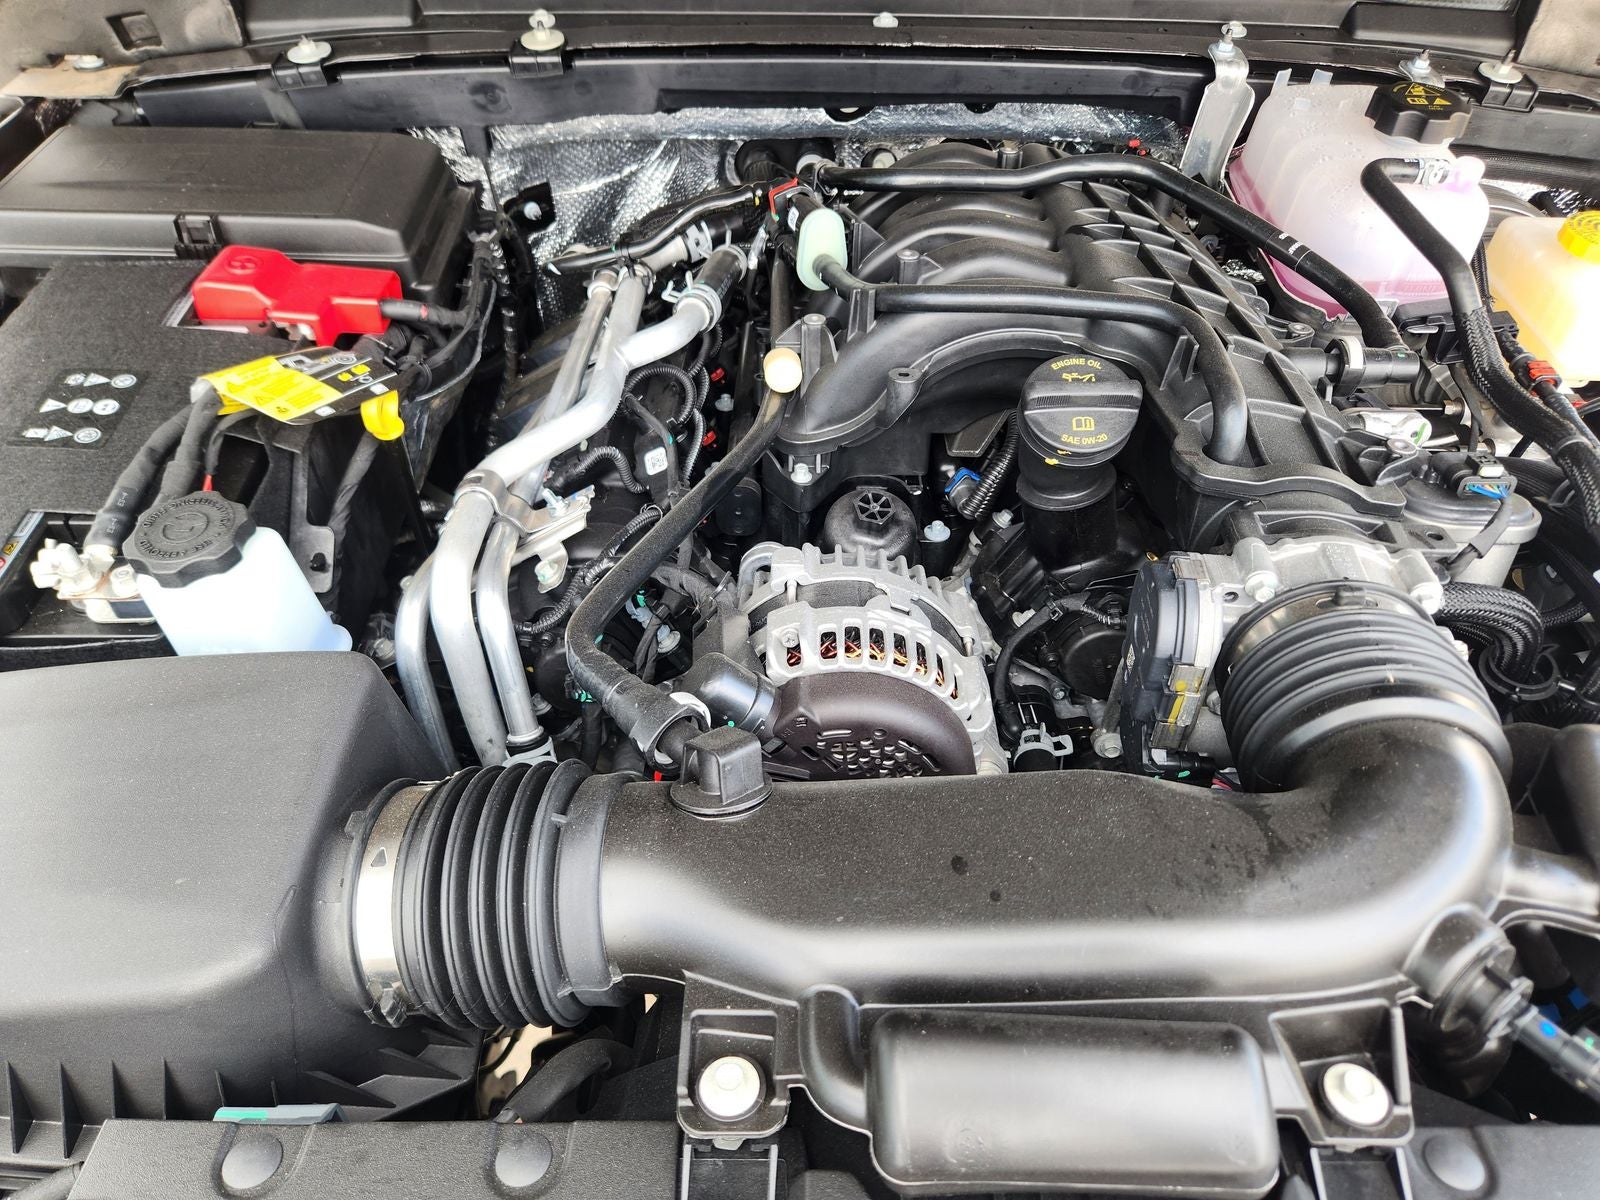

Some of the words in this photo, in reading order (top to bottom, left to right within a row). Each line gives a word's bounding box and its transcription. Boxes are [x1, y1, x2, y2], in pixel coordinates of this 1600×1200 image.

[1051, 358, 1086, 371] ENGINE
[1087, 359, 1102, 370] OIL
[1061, 433, 1080, 445] SAE
[1082, 433, 1108, 445] 0W-20
[169, 497, 219, 511] STEERING
[143, 507, 169, 529] FLUID
[140, 539, 188, 559] APPROVED
[192, 539, 214, 553] USE
